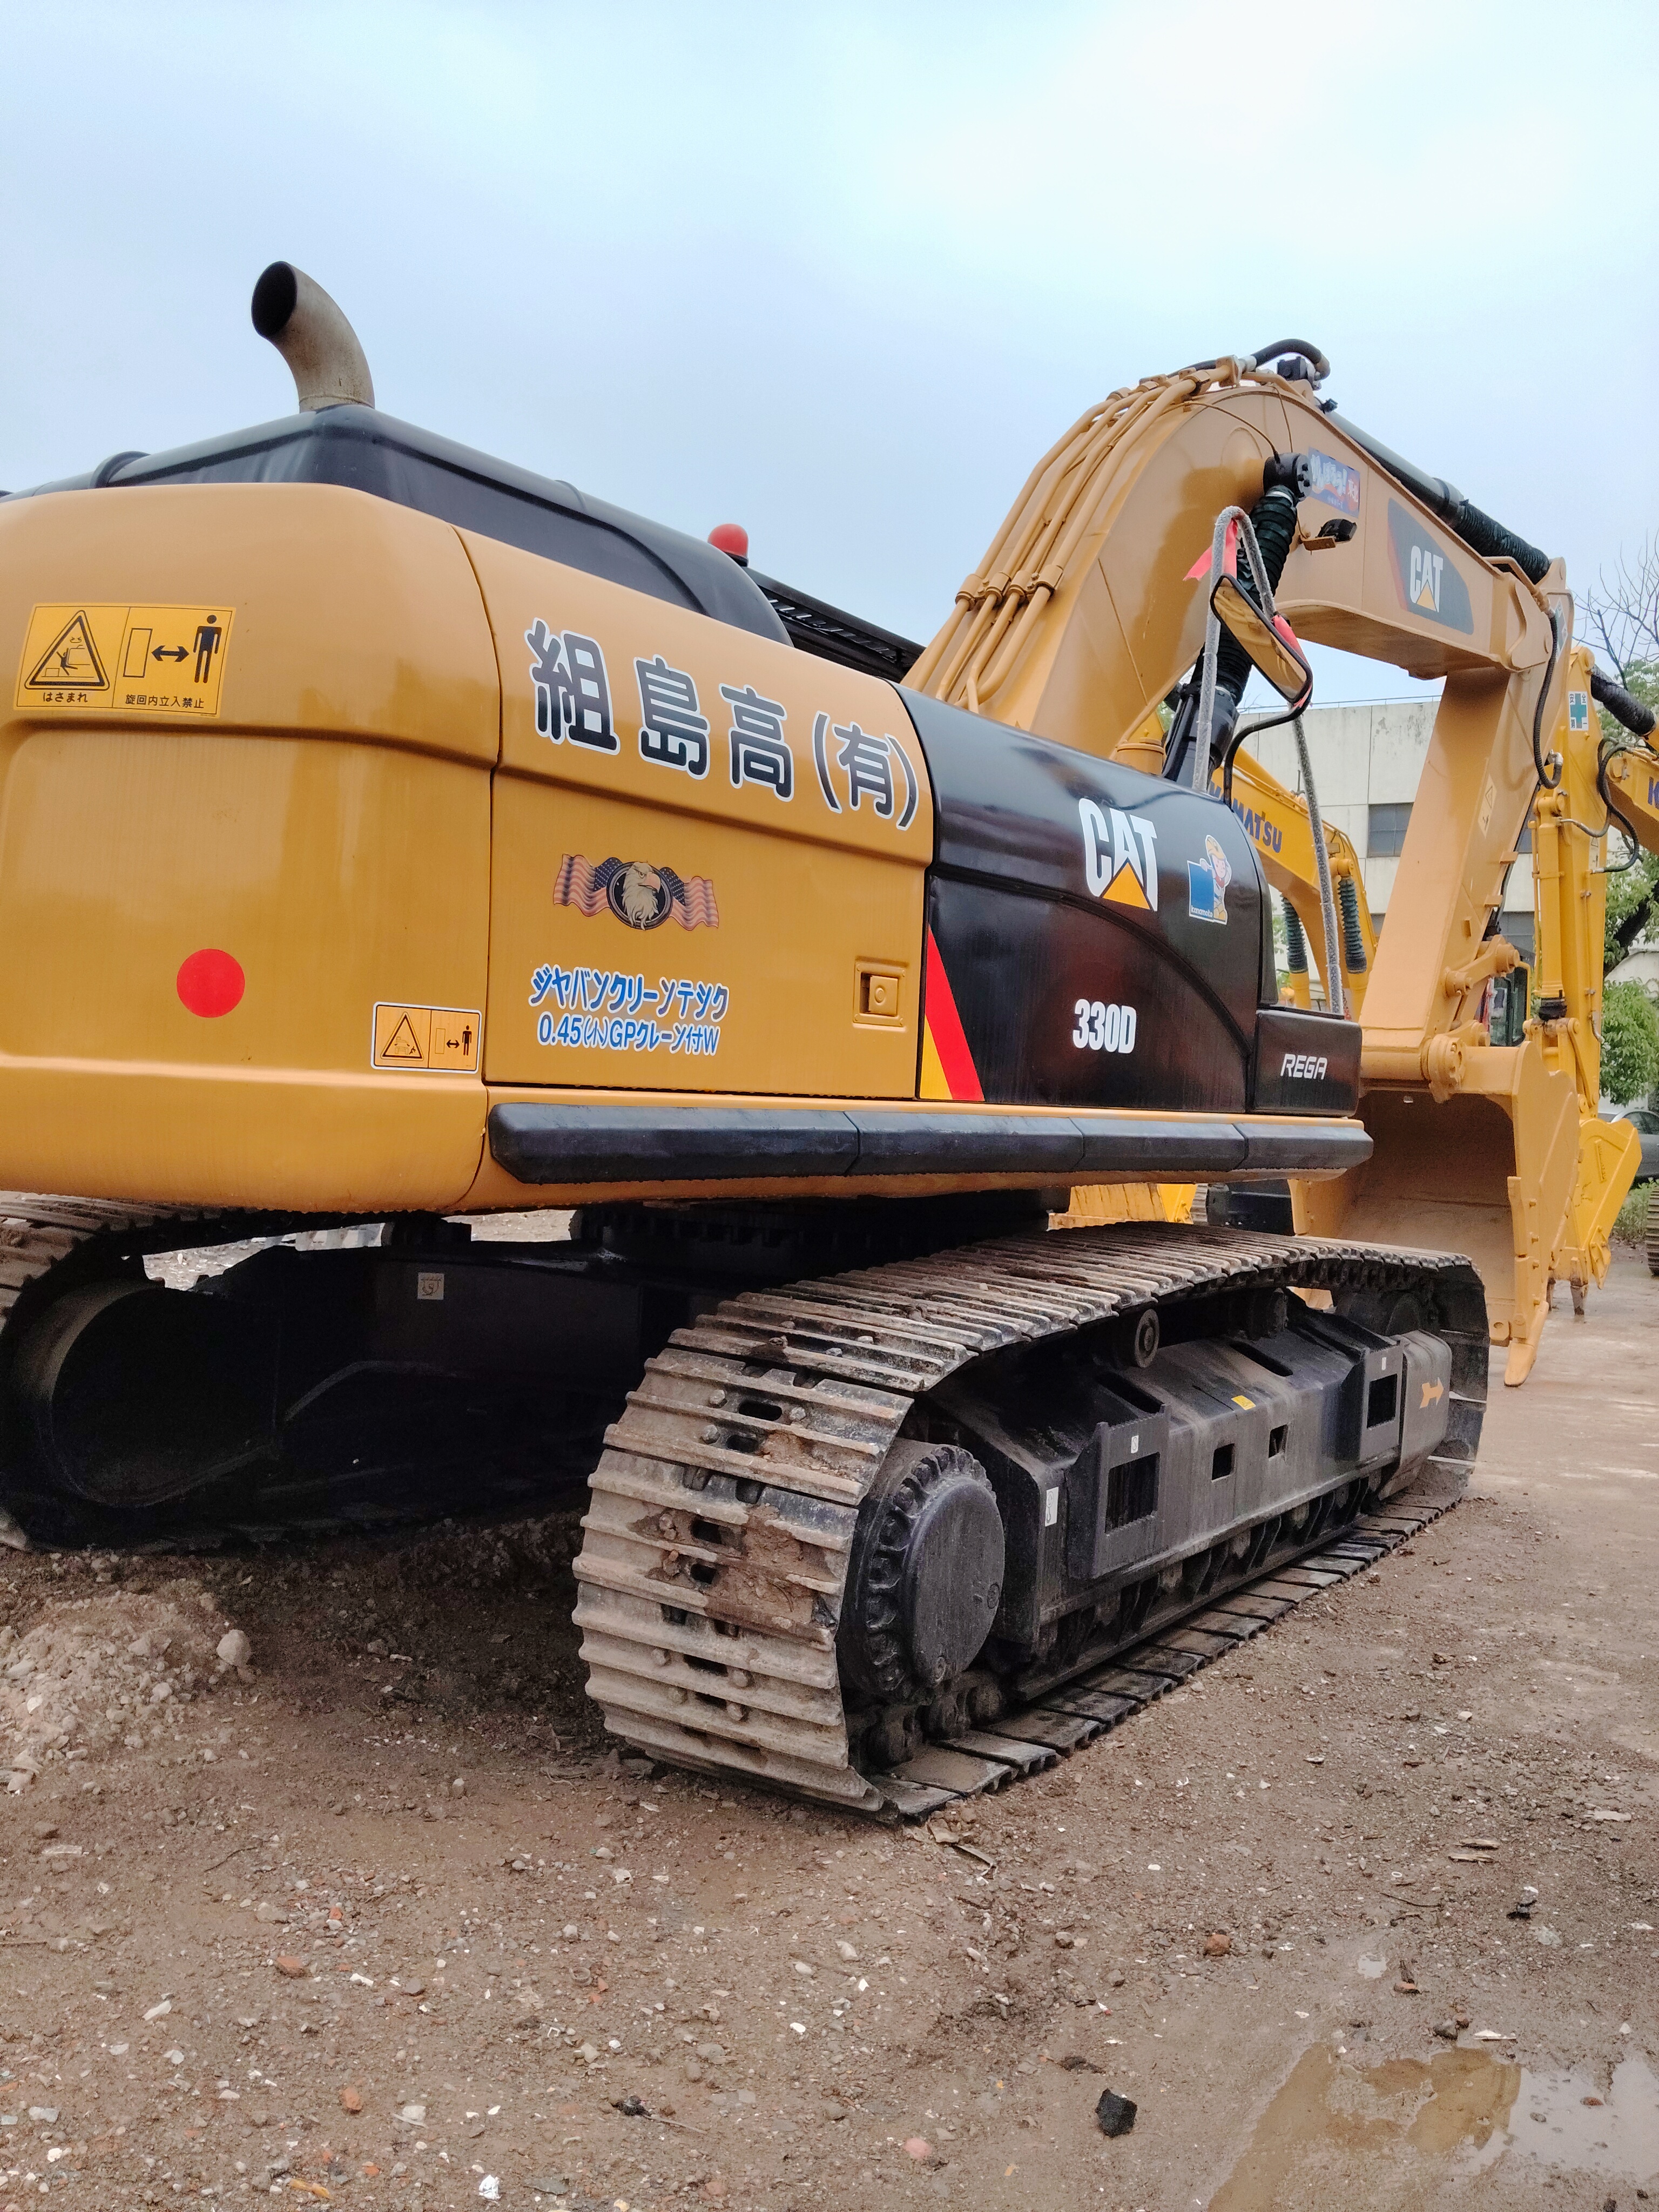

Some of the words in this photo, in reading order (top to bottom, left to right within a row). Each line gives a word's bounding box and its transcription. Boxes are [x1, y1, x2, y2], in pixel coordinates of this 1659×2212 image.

[1410, 545, 1444, 612] CAT
[42, 692, 89, 703] はさまれ
[125, 693, 205, 709] 旋回内立入禁止
[1079, 798, 1158, 912] CAT
[1073, 998, 1137, 1054] 330D
[1280, 1053, 1328, 1080] REGA
